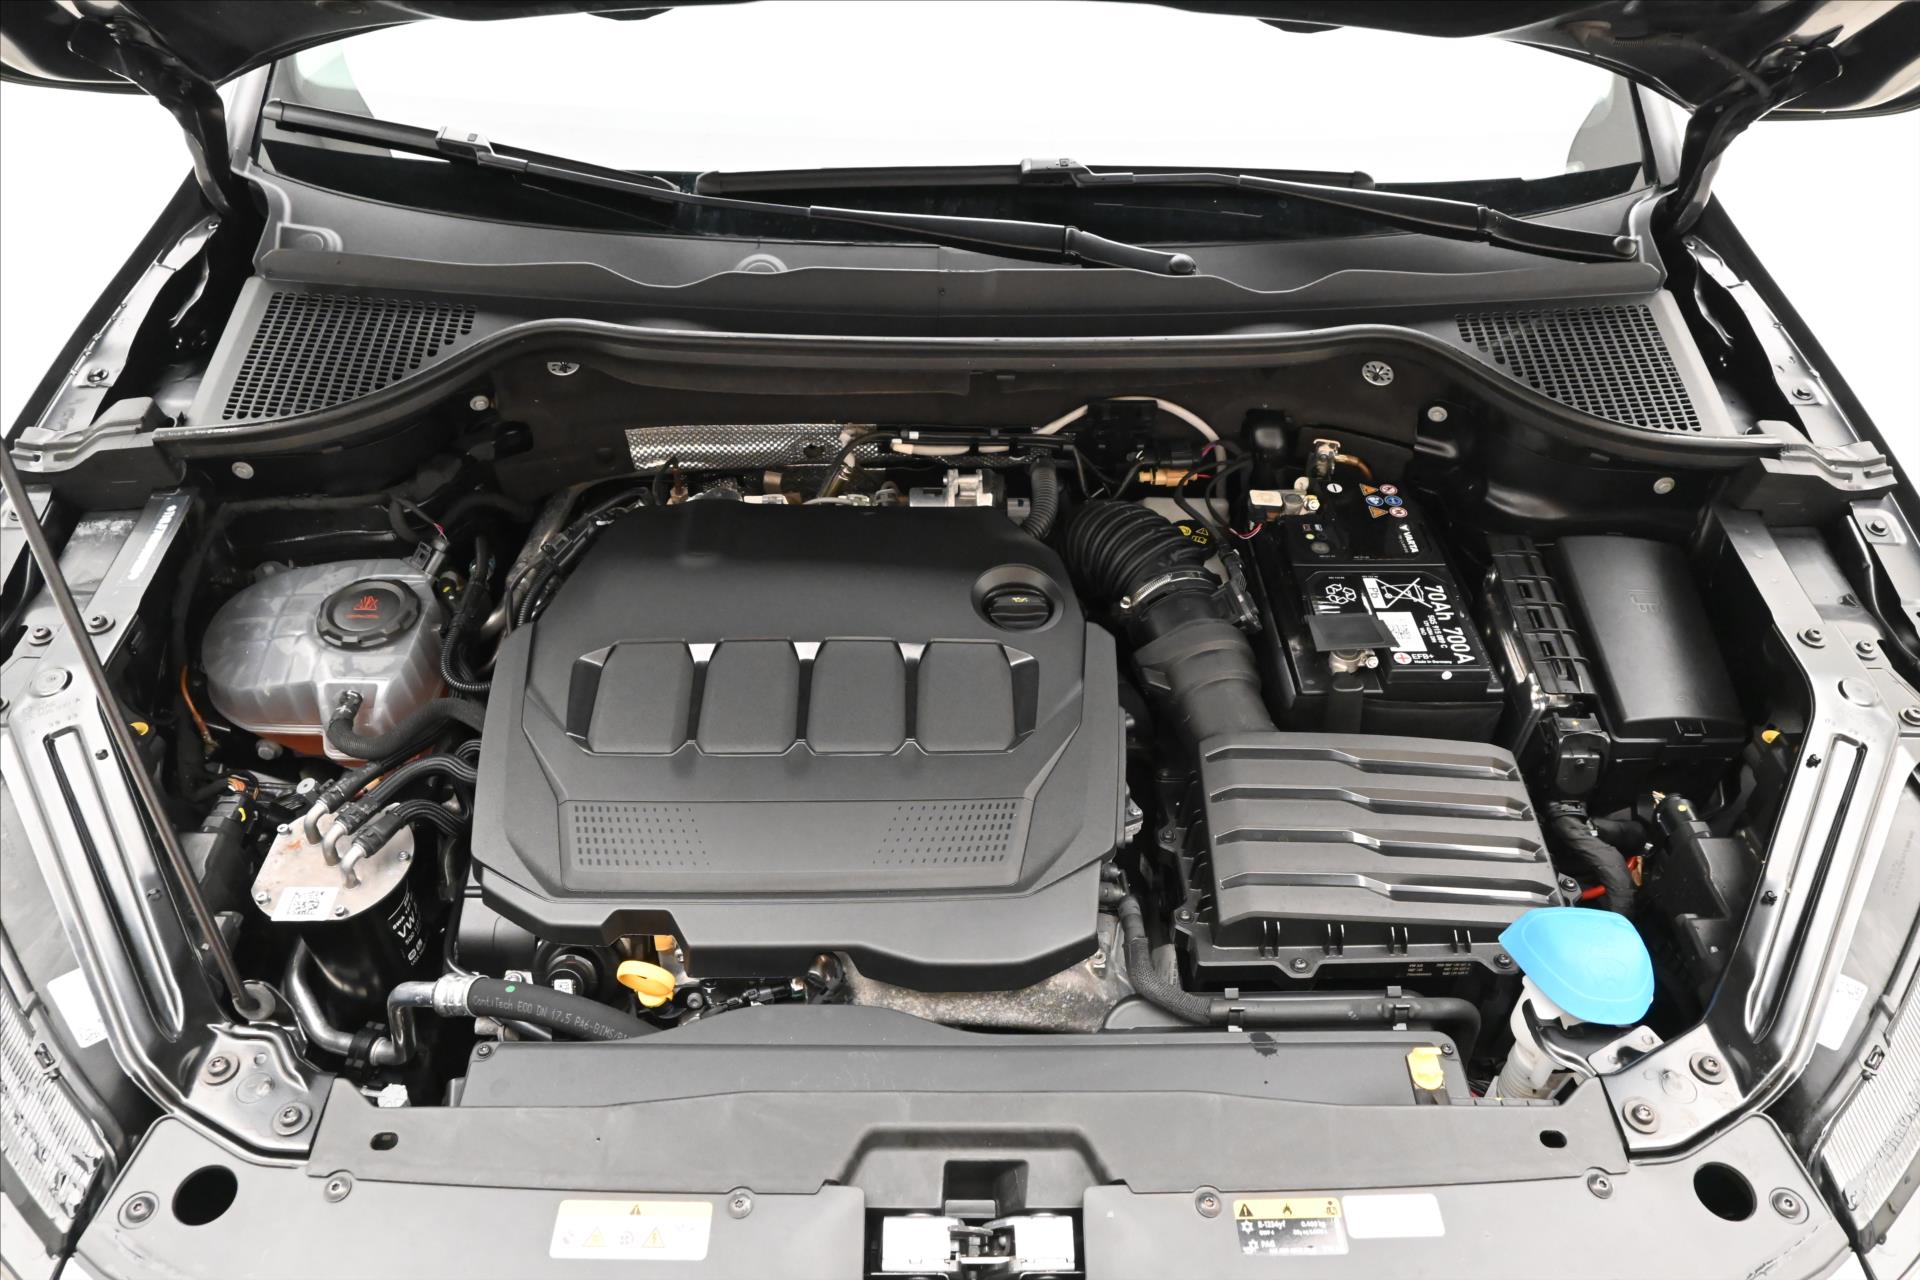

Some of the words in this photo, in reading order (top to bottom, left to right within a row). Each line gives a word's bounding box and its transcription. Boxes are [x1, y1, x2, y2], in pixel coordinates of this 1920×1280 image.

[1403, 531, 1419, 553] VARTA
[1368, 587, 1379, 598] Pb
[1424, 585, 1455, 621] 70Ah
[1442, 626, 1476, 664] 700A
[397, 909, 415, 938] VW
[473, 995, 513, 1010] ContiTech
[536, 1005, 548, 1018] DN
